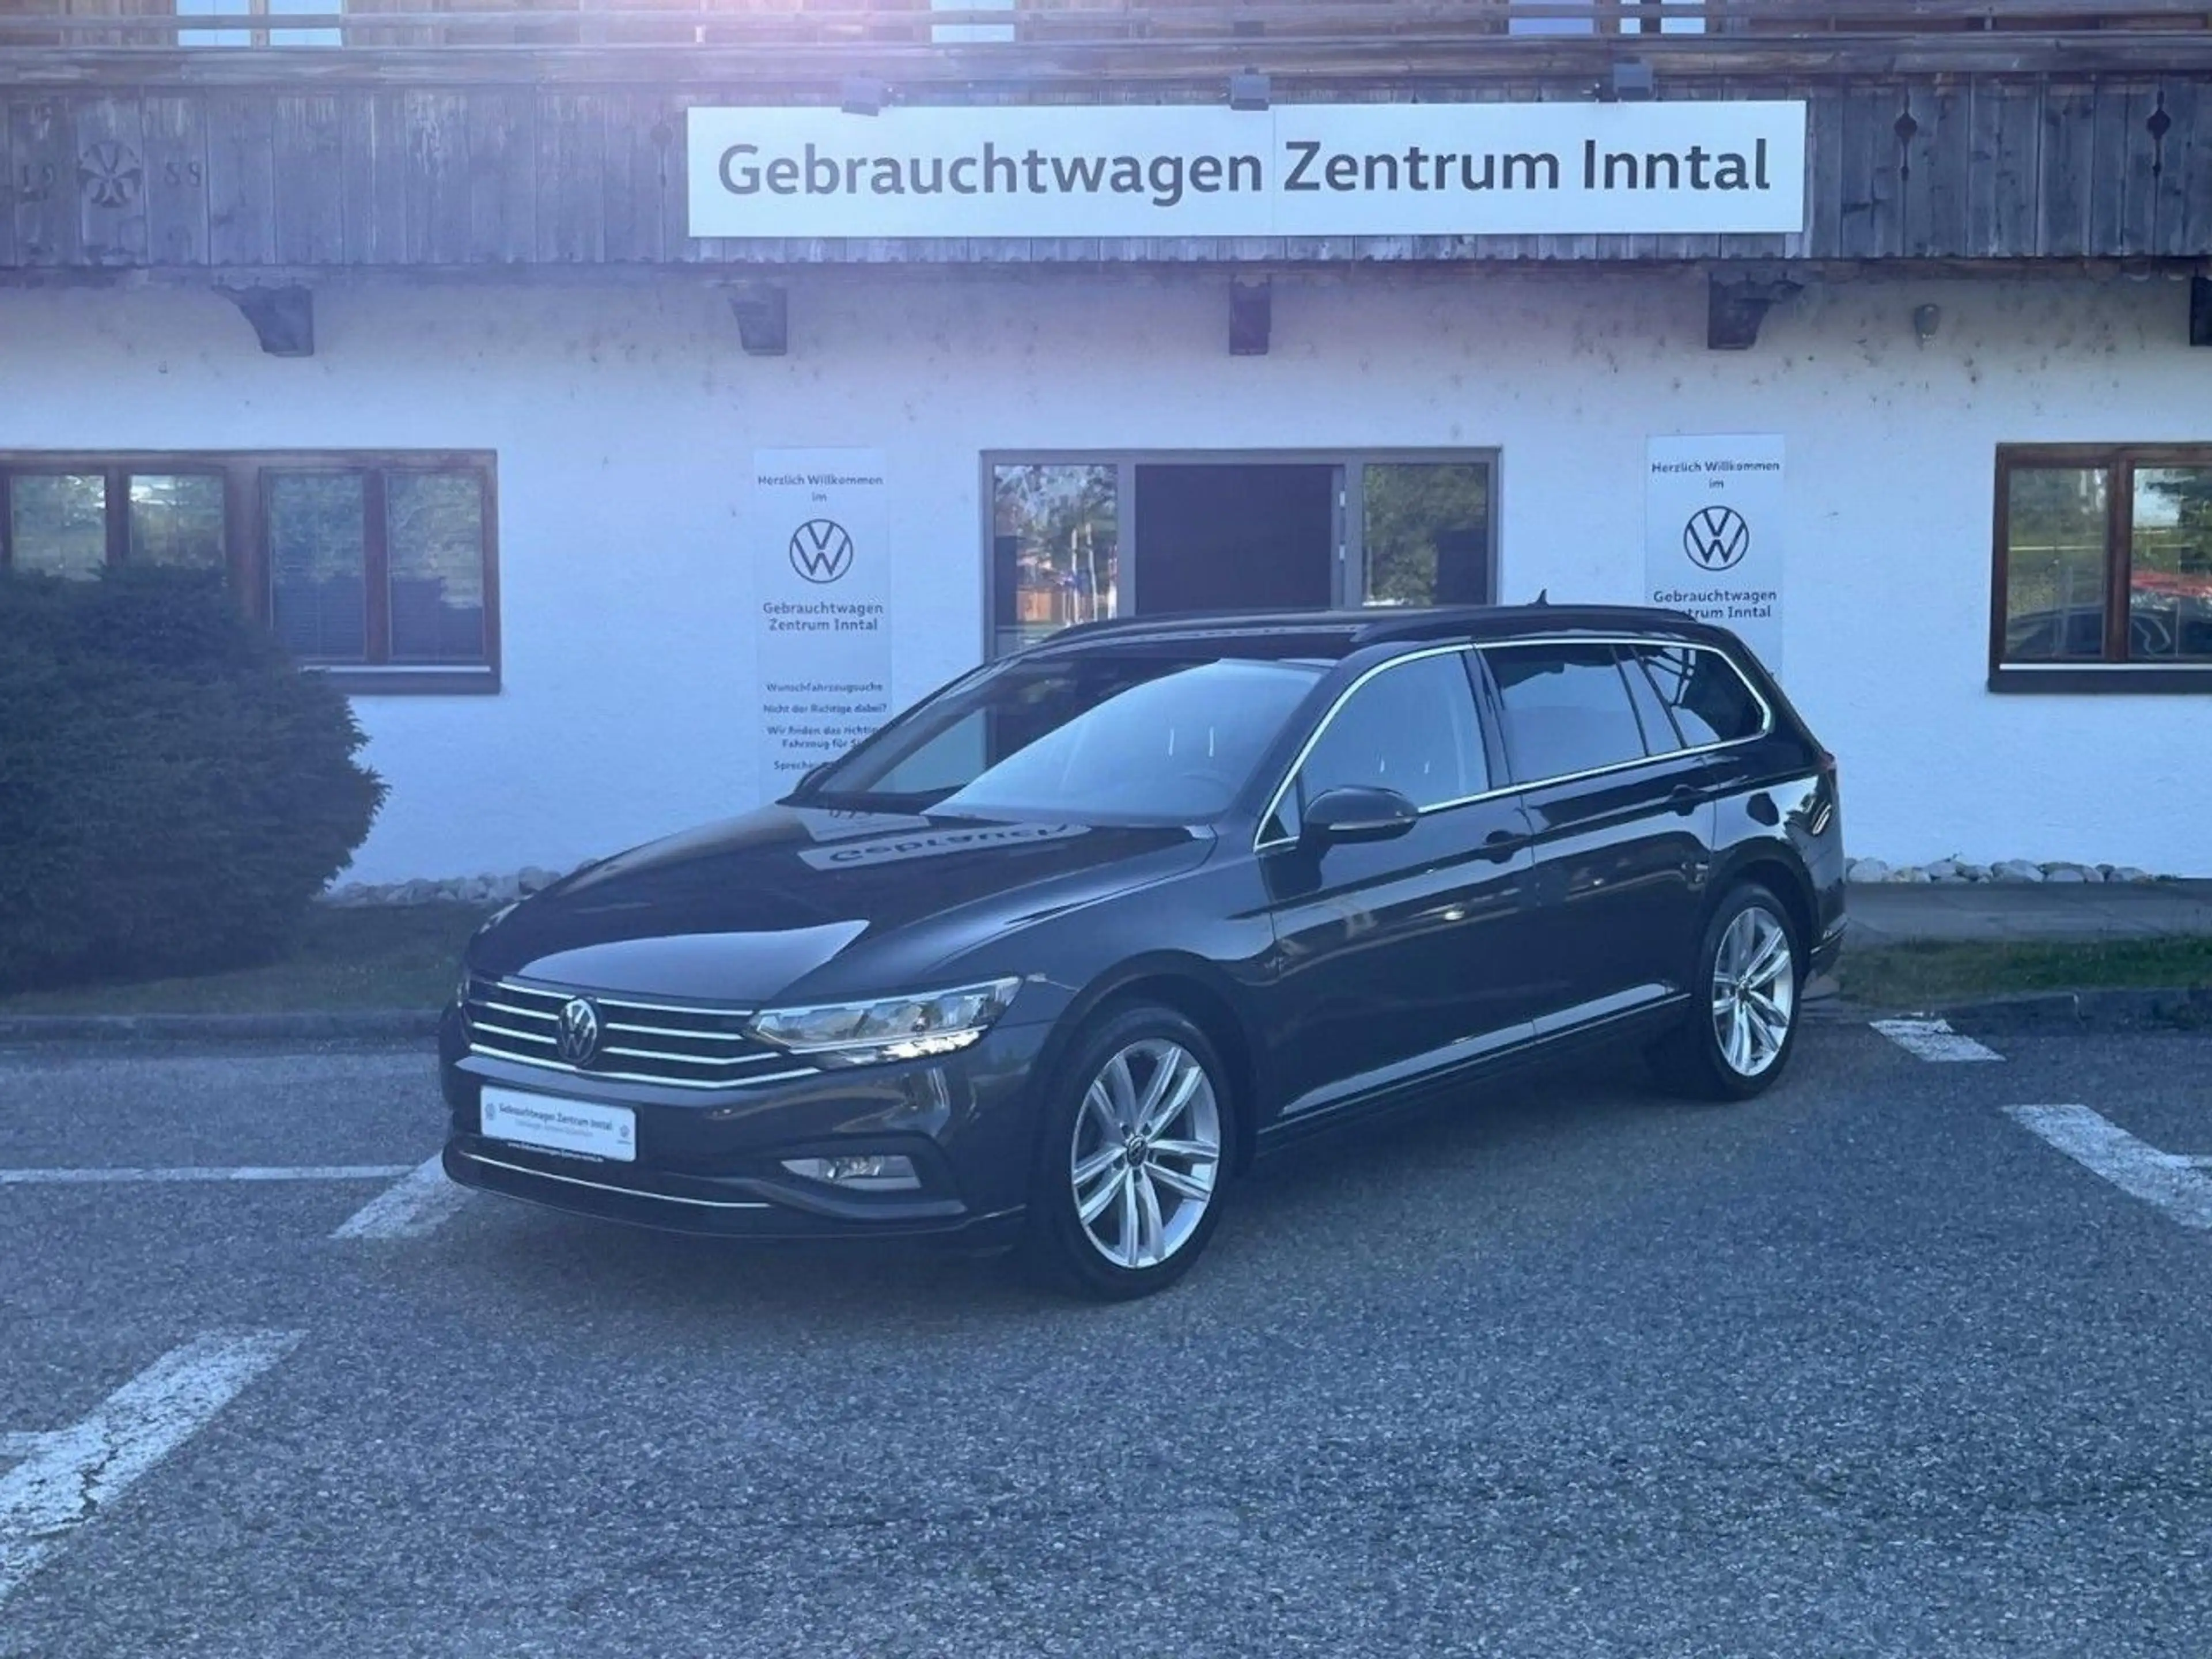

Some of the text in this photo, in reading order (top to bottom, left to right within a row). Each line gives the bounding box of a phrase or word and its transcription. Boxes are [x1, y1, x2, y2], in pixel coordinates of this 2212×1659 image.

[719, 137, 1771, 207] Gebrauchtwagen Zentrum Inntal
[1652, 461, 1780, 472] Herzlich Willkommen
[757, 474, 883, 486] Herzlich Willkommen
[1709, 479, 1724, 489] im
[811, 491, 827, 502] im
[1683, 505, 1750, 571] VW
[789, 518, 854, 584] VW
[1653, 589, 1777, 604] Gebrauchtwagen
[763, 601, 884, 618] Gebrauchtwagen
[1728, 605, 1771, 618] Inntal
[768, 618, 878, 631] Zentrum Inntal
[766, 681, 883, 694] Wunschfahrzeugsuche
[763, 704, 790, 714] Nicht
[766, 726, 786, 735] Wir
[787, 726, 821, 735] finden
[824, 726, 840, 735] das
[782, 739, 830, 750] Fahrzeug
[832, 738, 849, 748] für
